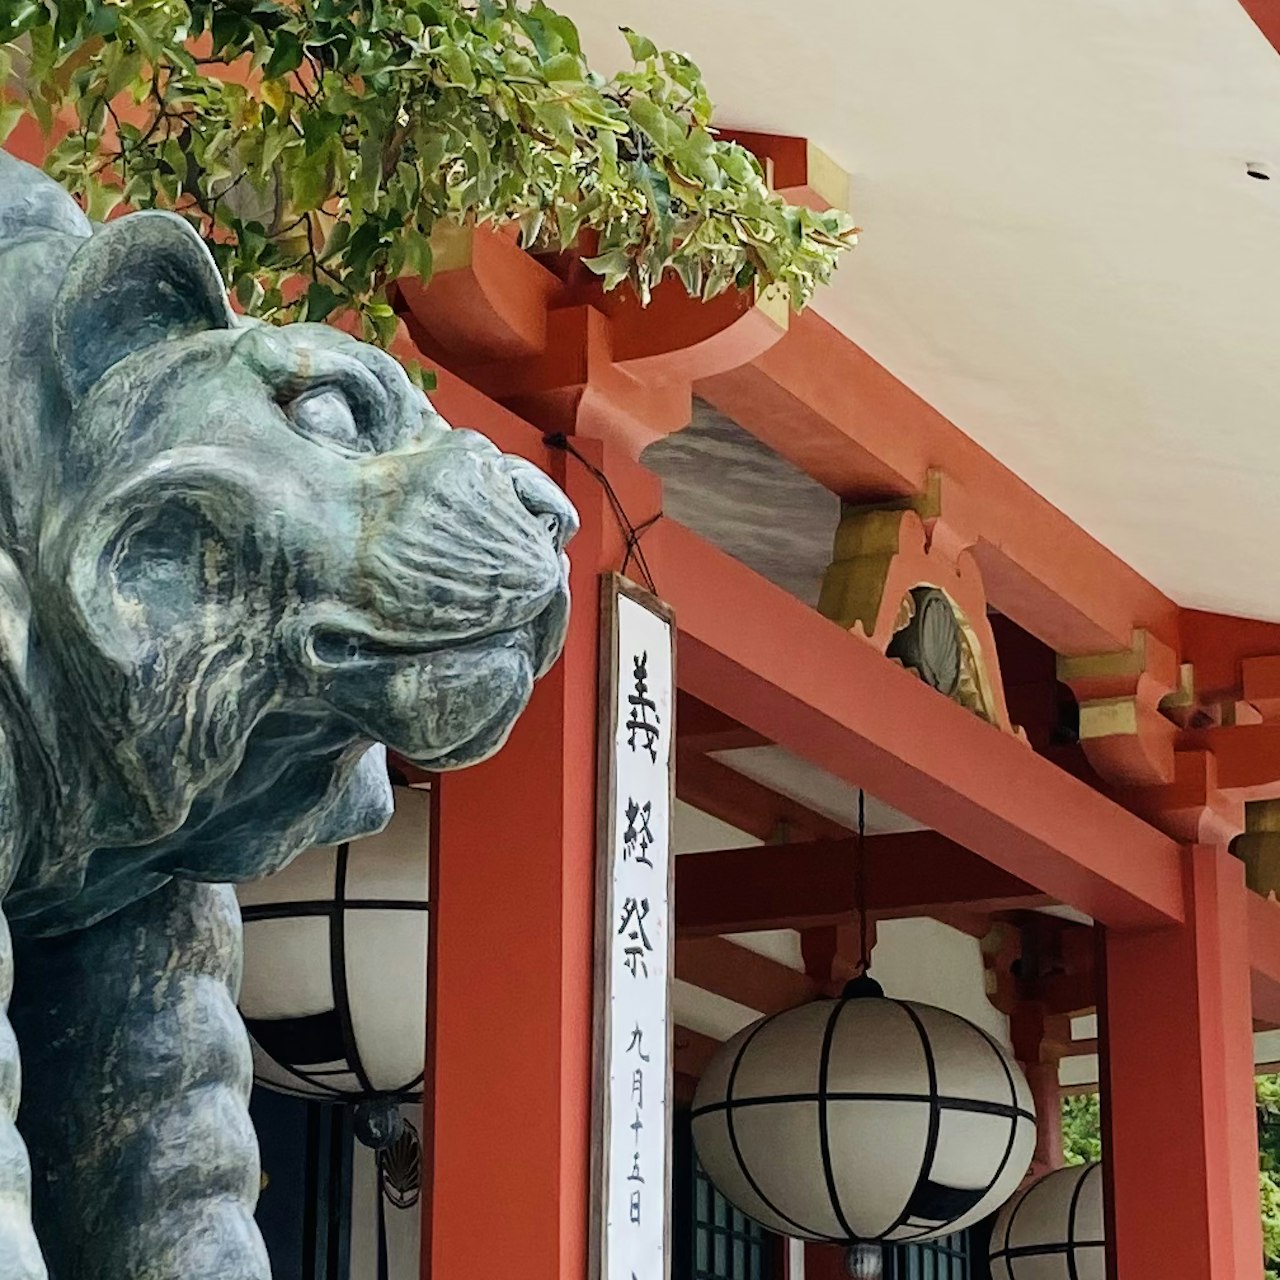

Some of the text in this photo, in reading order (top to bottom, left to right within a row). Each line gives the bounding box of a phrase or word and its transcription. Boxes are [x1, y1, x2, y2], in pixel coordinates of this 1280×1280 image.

[618, 650, 660, 979] 義経祭
[625, 1018, 650, 1227] 九月十五日
